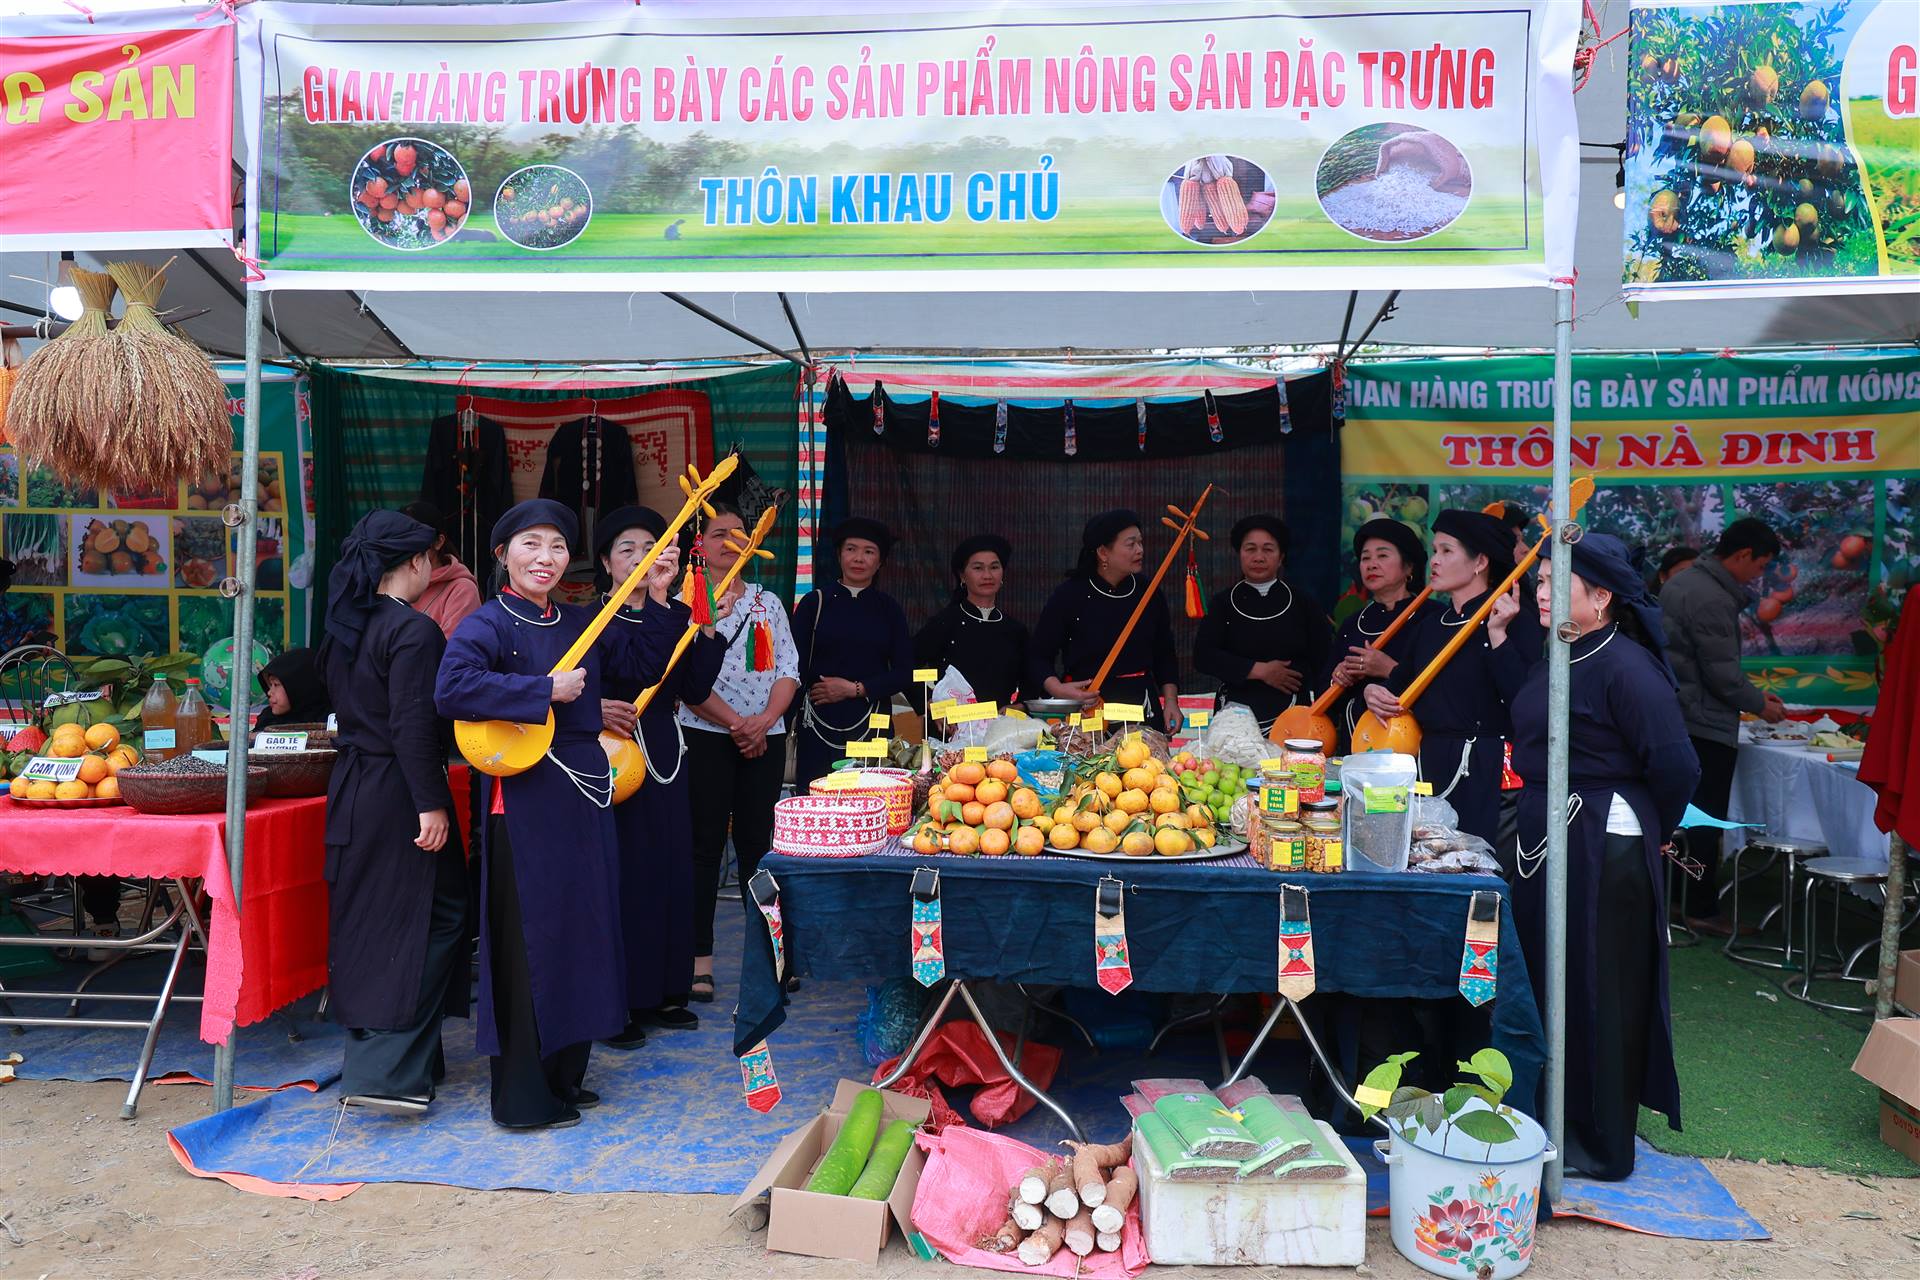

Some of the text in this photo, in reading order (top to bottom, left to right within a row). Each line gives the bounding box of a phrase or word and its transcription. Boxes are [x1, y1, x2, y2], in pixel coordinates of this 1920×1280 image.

[64, 44, 196, 123] SẢN
[303, 33, 1495, 125] GIAN HÀNG TRƯNG BÀY CÁC SẢN PHẨM NÔNG SẢN ĐẶC TRƯNG
[700, 153, 1060, 226] THÔN KHAU CHỦ
[1409, 375, 1488, 409] HÀNG
[1496, 377, 1591, 409] TRƯG
[1600, 373, 1658, 408] BÀY
[1667, 368, 1728, 408] SẢN
[1738, 364, 1829, 406] PHẨM
[1441, 424, 1876, 468] THÔN NÀ ĐINH
[30, 762, 78, 775] CAM VINH
